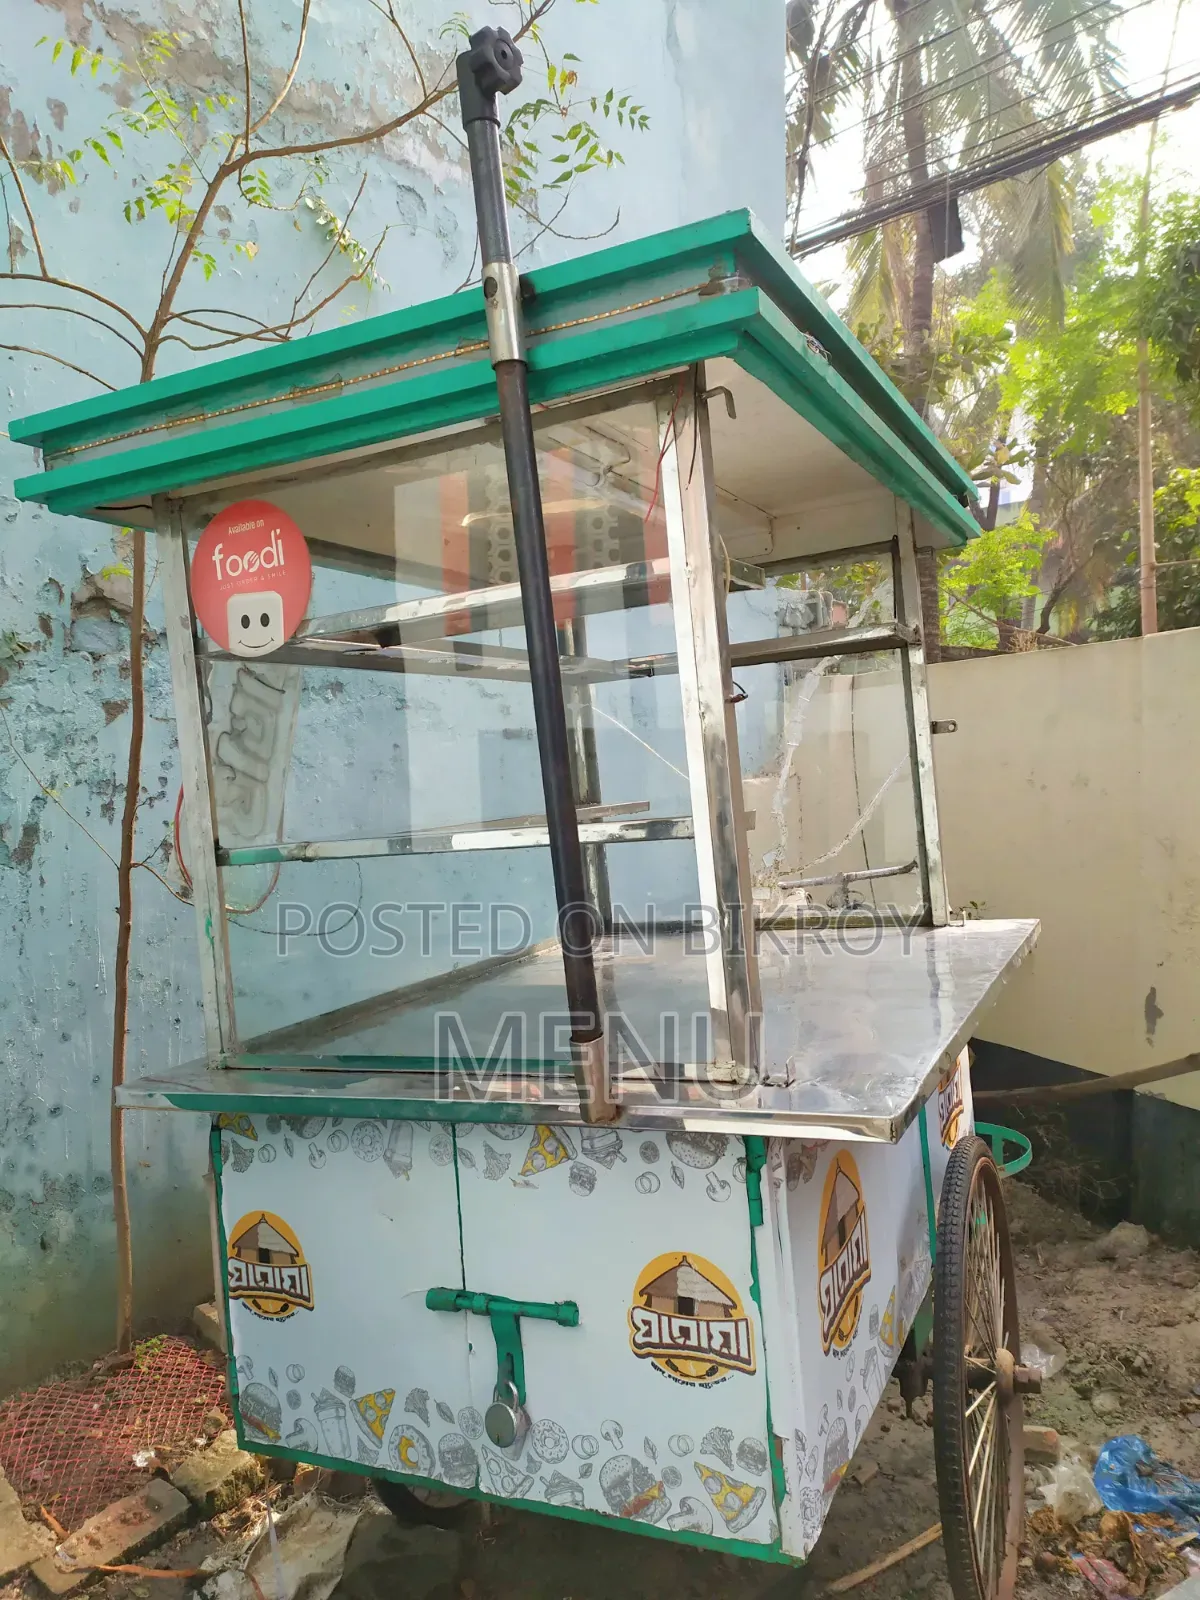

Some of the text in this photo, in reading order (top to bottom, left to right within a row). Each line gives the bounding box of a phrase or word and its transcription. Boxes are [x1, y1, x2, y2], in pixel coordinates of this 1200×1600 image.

[228, 519, 265, 536] Available on
[212, 528, 285, 581] foodi
[219, 582, 235, 591] JUST
[236, 577, 258, 587] ORDER
[267, 571, 287, 581] SMILE
